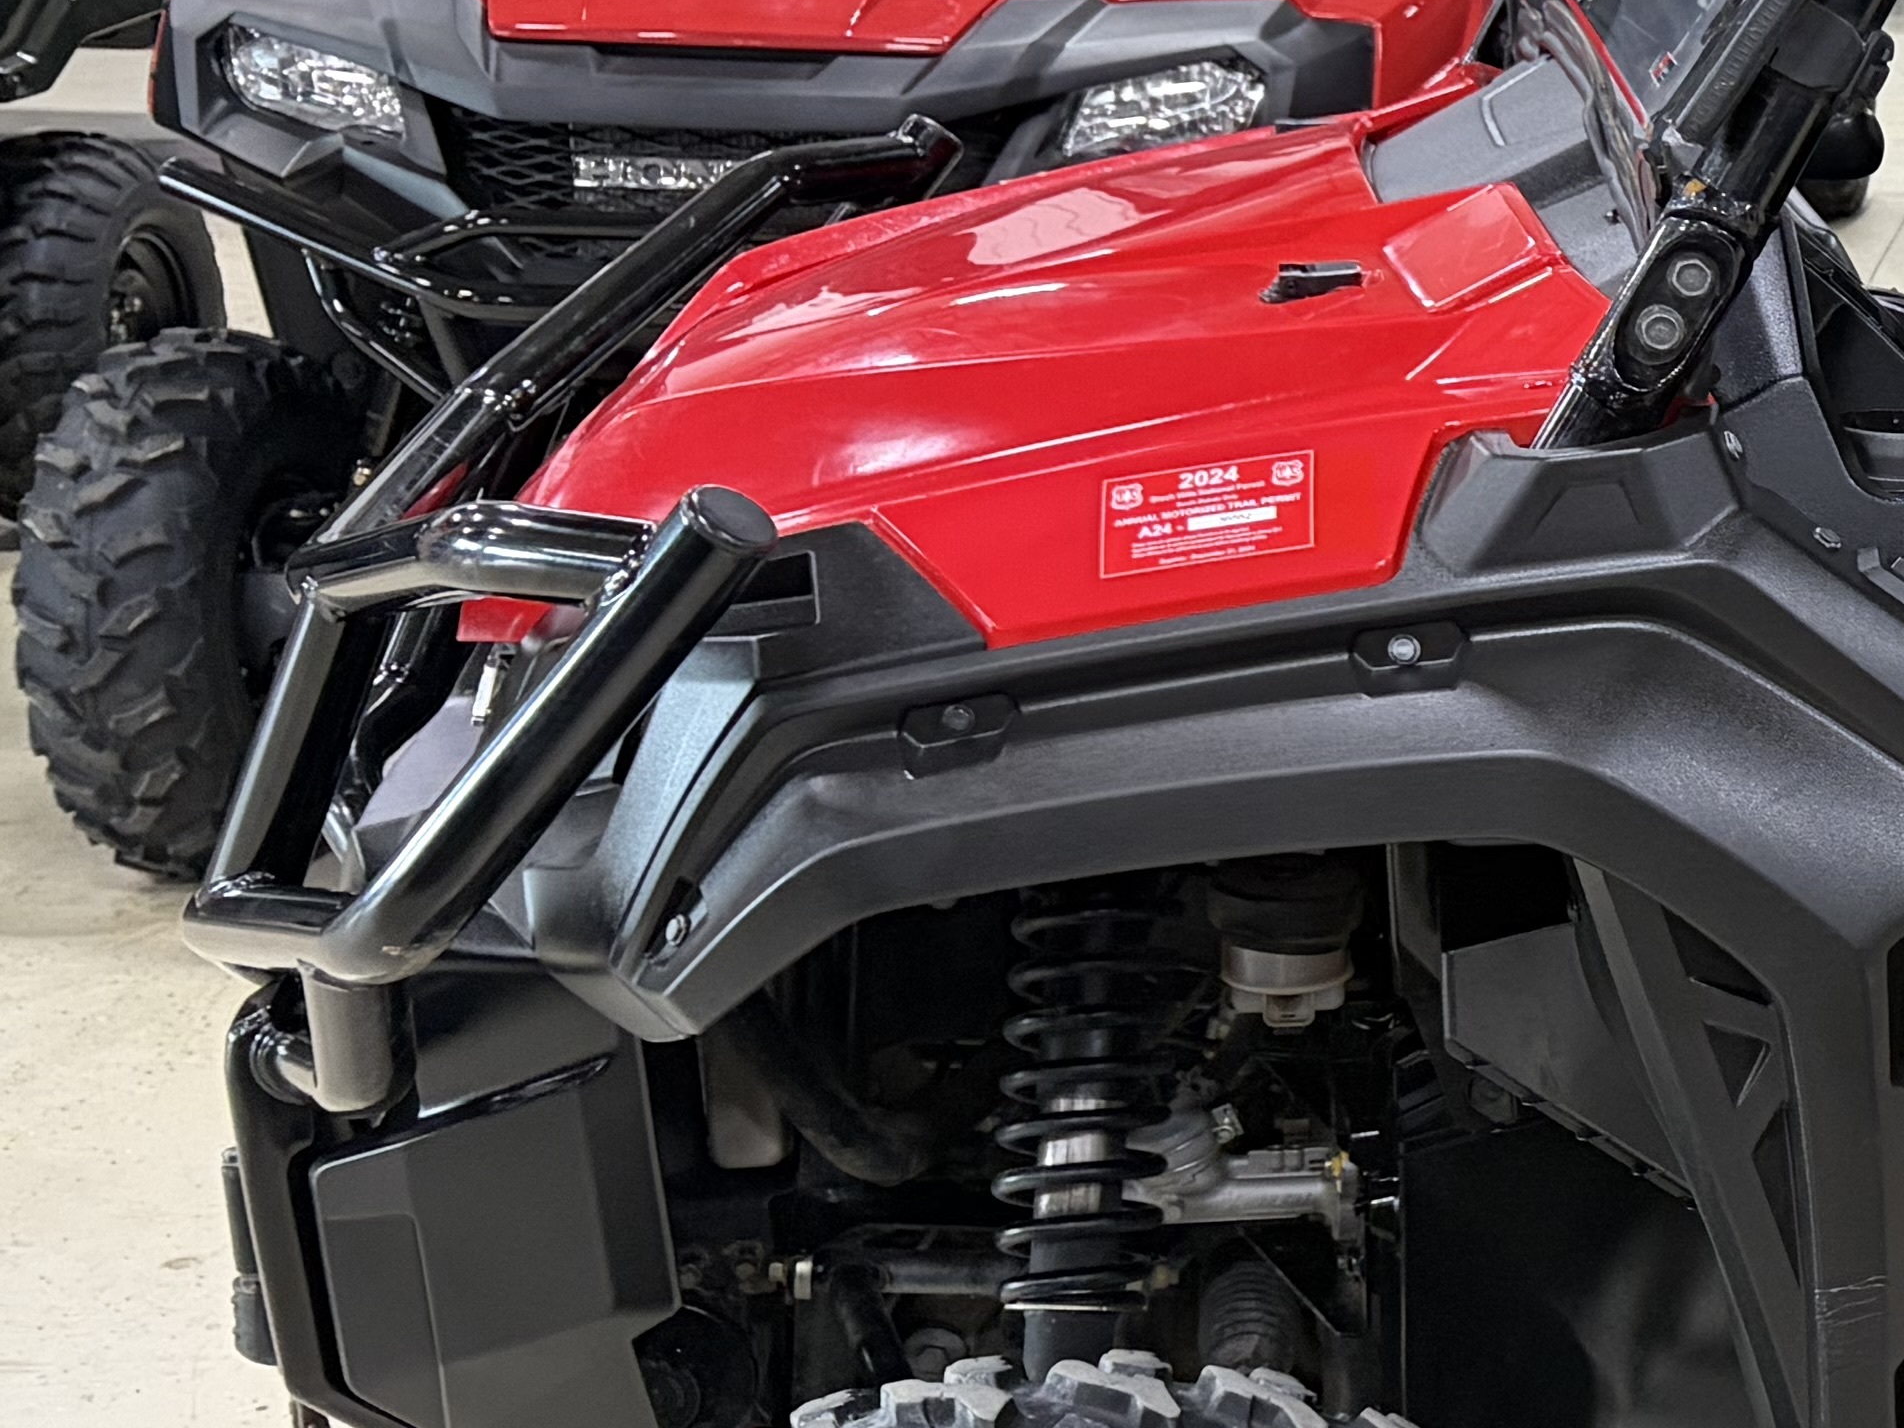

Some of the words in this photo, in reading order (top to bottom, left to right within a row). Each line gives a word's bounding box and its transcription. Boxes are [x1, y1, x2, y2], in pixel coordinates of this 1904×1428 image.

[1177, 465, 1240, 490] 2024
[1114, 512, 1160, 528] ANNUAL
[1161, 502, 1226, 521] MOTORIZED
[1227, 498, 1258, 511] TRAIL
[1260, 492, 1302, 505] PERMIT
[1137, 522, 1173, 540] A24
